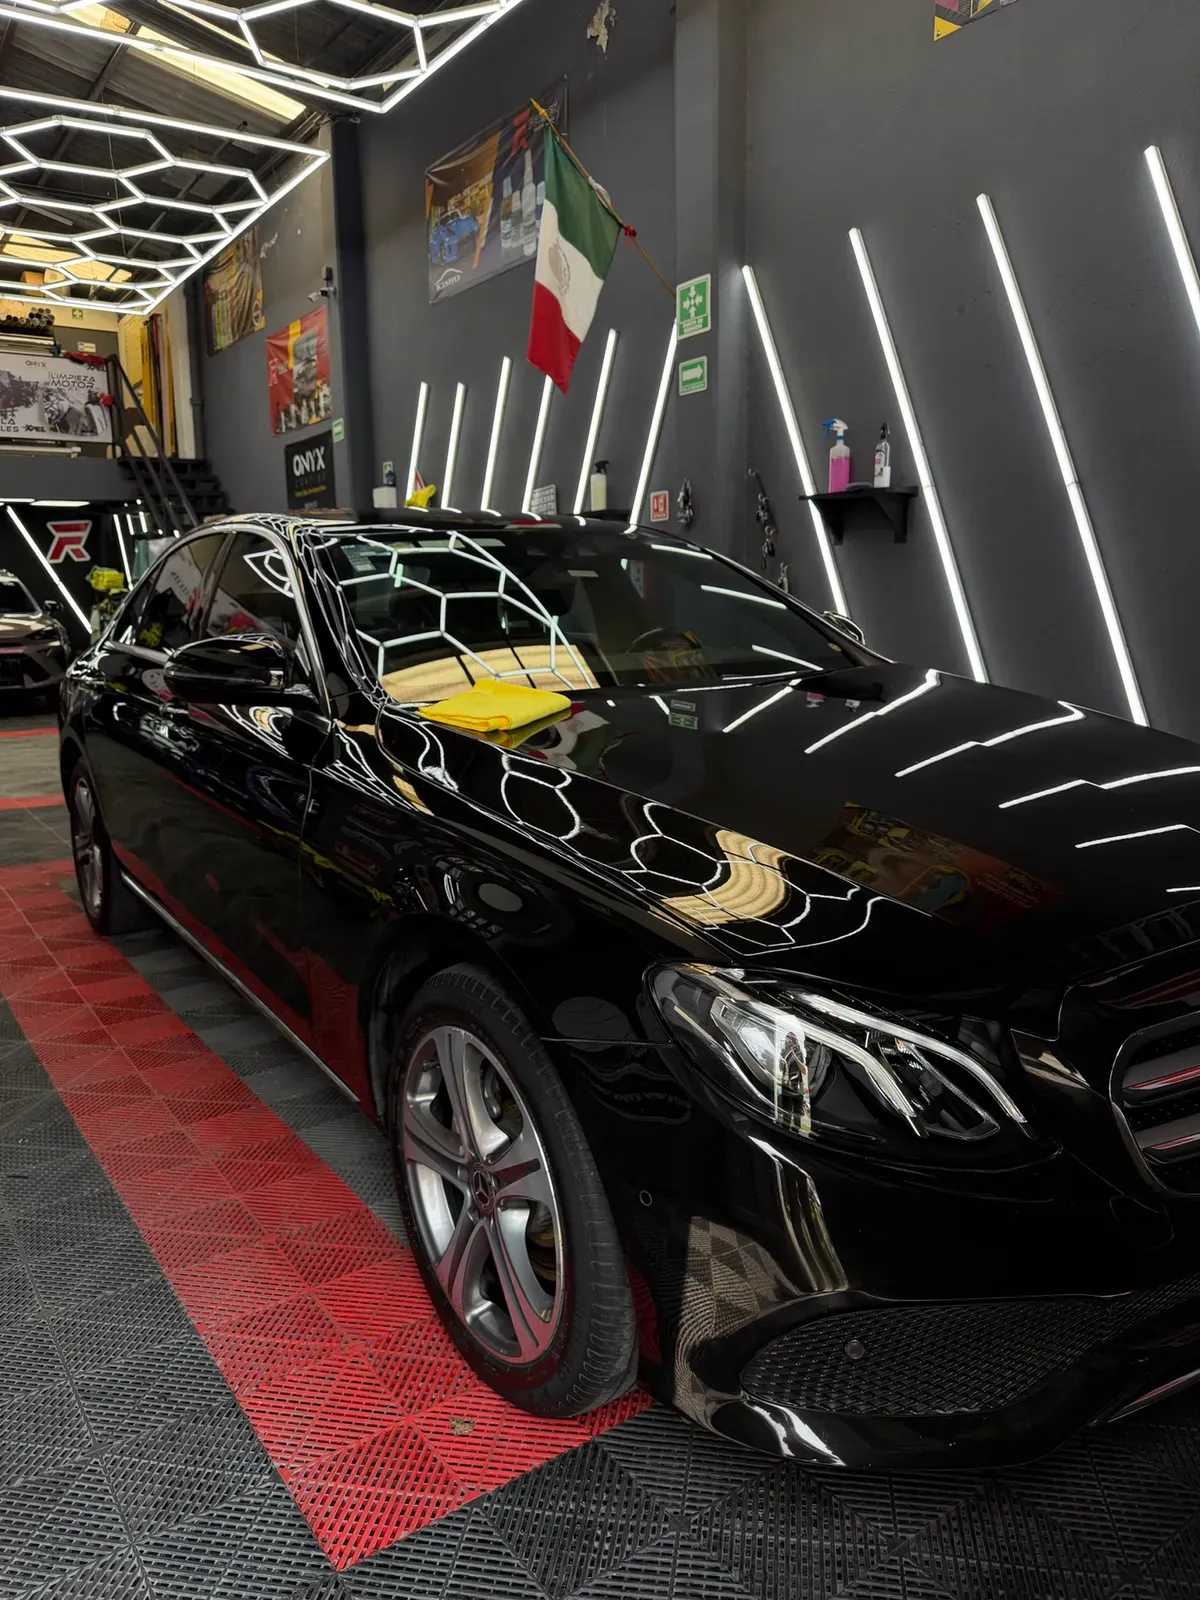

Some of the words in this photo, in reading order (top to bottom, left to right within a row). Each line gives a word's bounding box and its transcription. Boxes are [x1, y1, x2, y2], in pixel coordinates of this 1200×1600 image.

[50, 372, 96, 382] LIMPIEZA
[50, 379, 95, 389] MOTOR
[293, 447, 325, 477] ONYX
